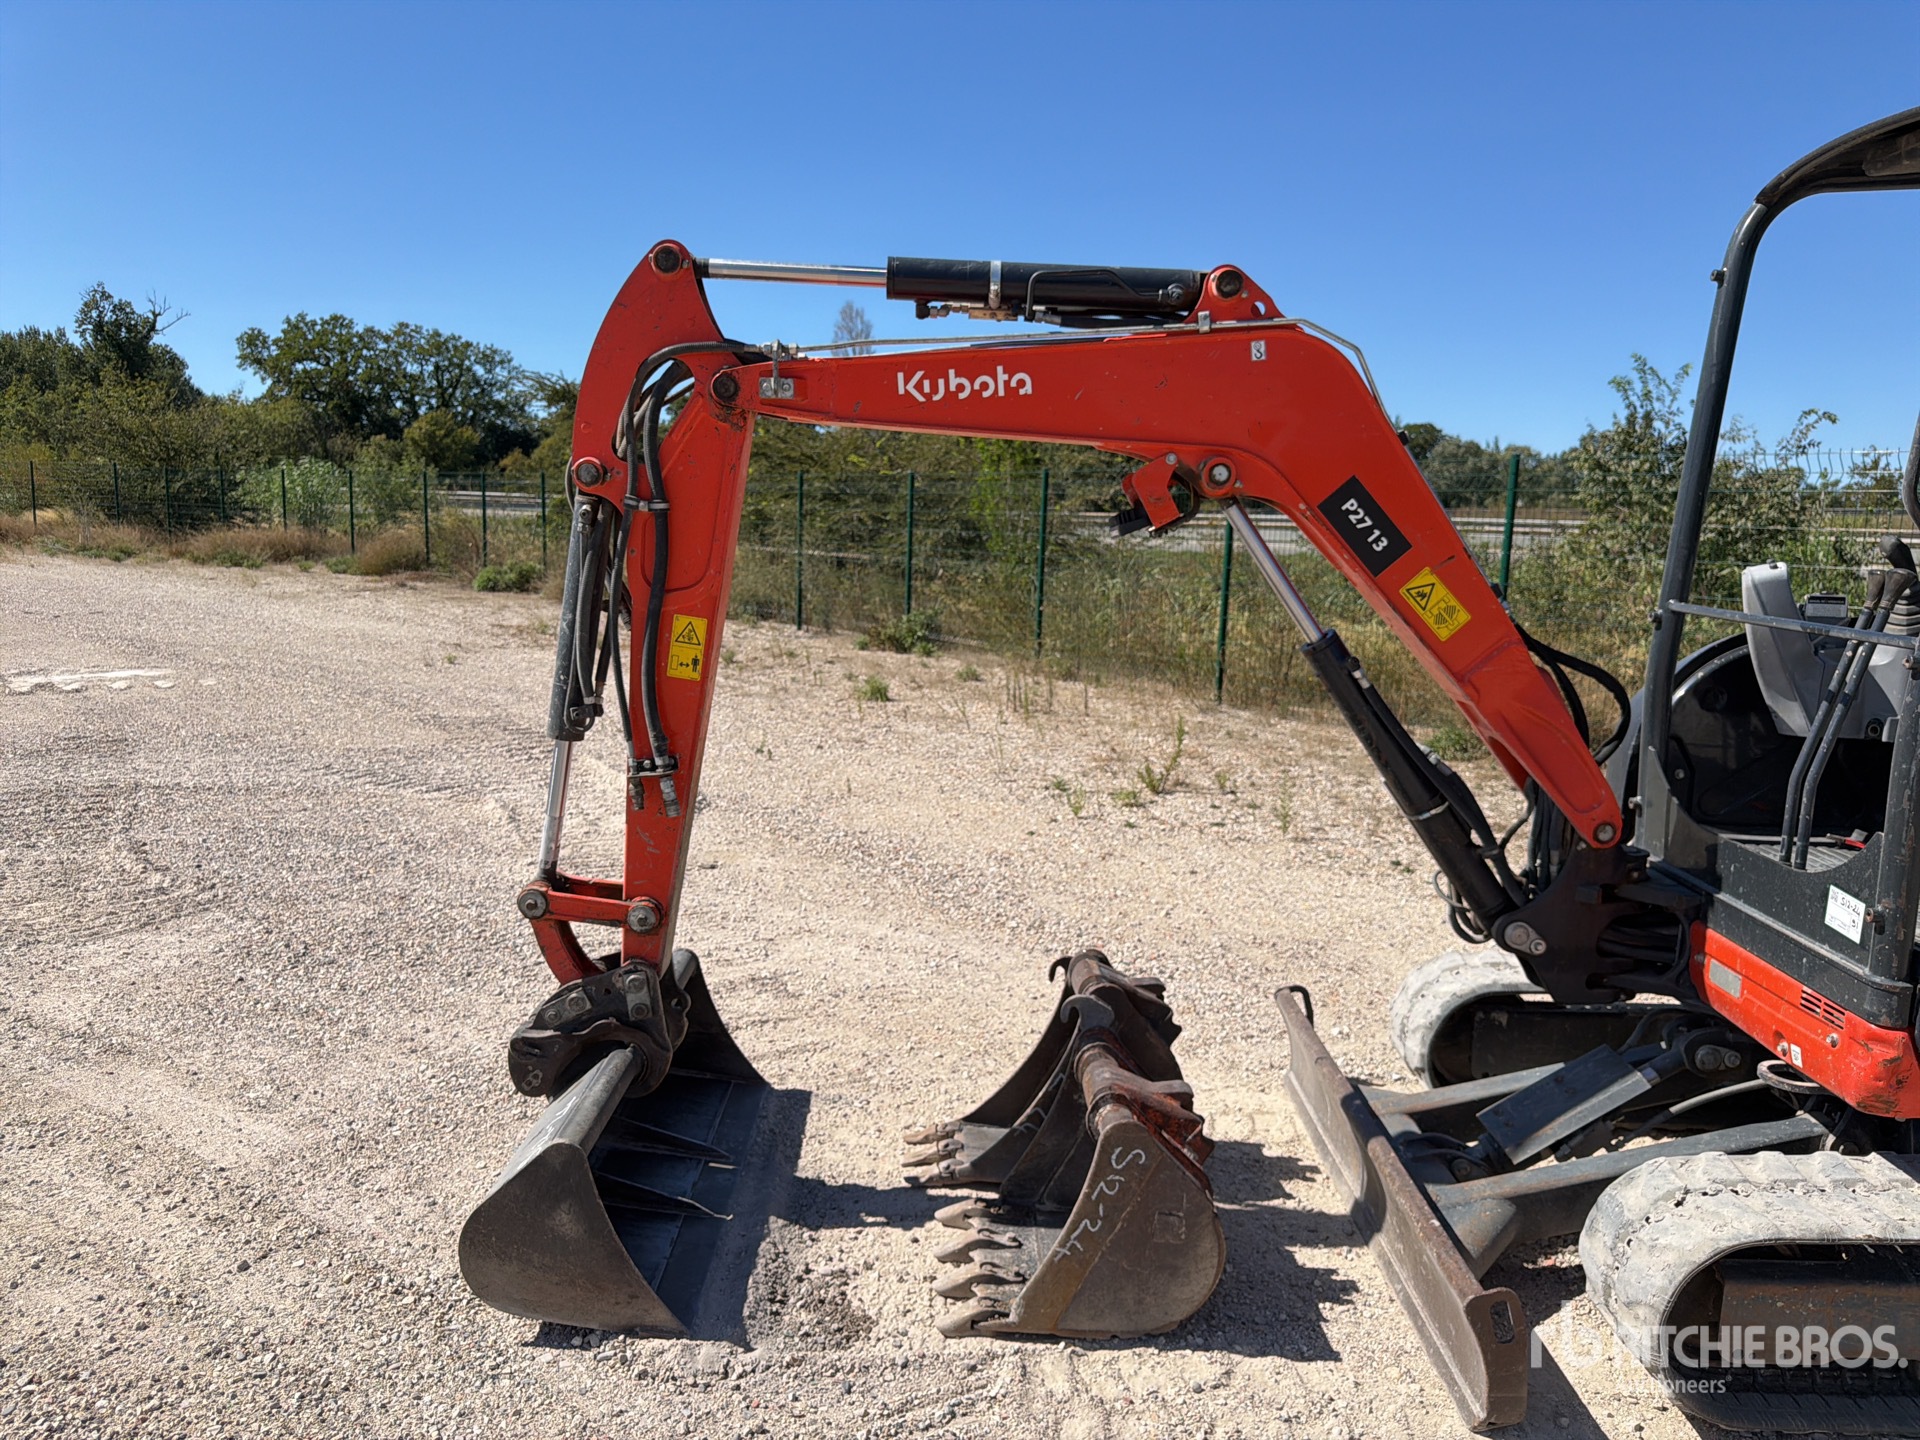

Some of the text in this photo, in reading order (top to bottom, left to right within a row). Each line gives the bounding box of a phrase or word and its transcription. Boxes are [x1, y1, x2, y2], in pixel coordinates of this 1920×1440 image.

[897, 365, 1033, 402] Kubota
[1341, 498, 1389, 552] P27 13
